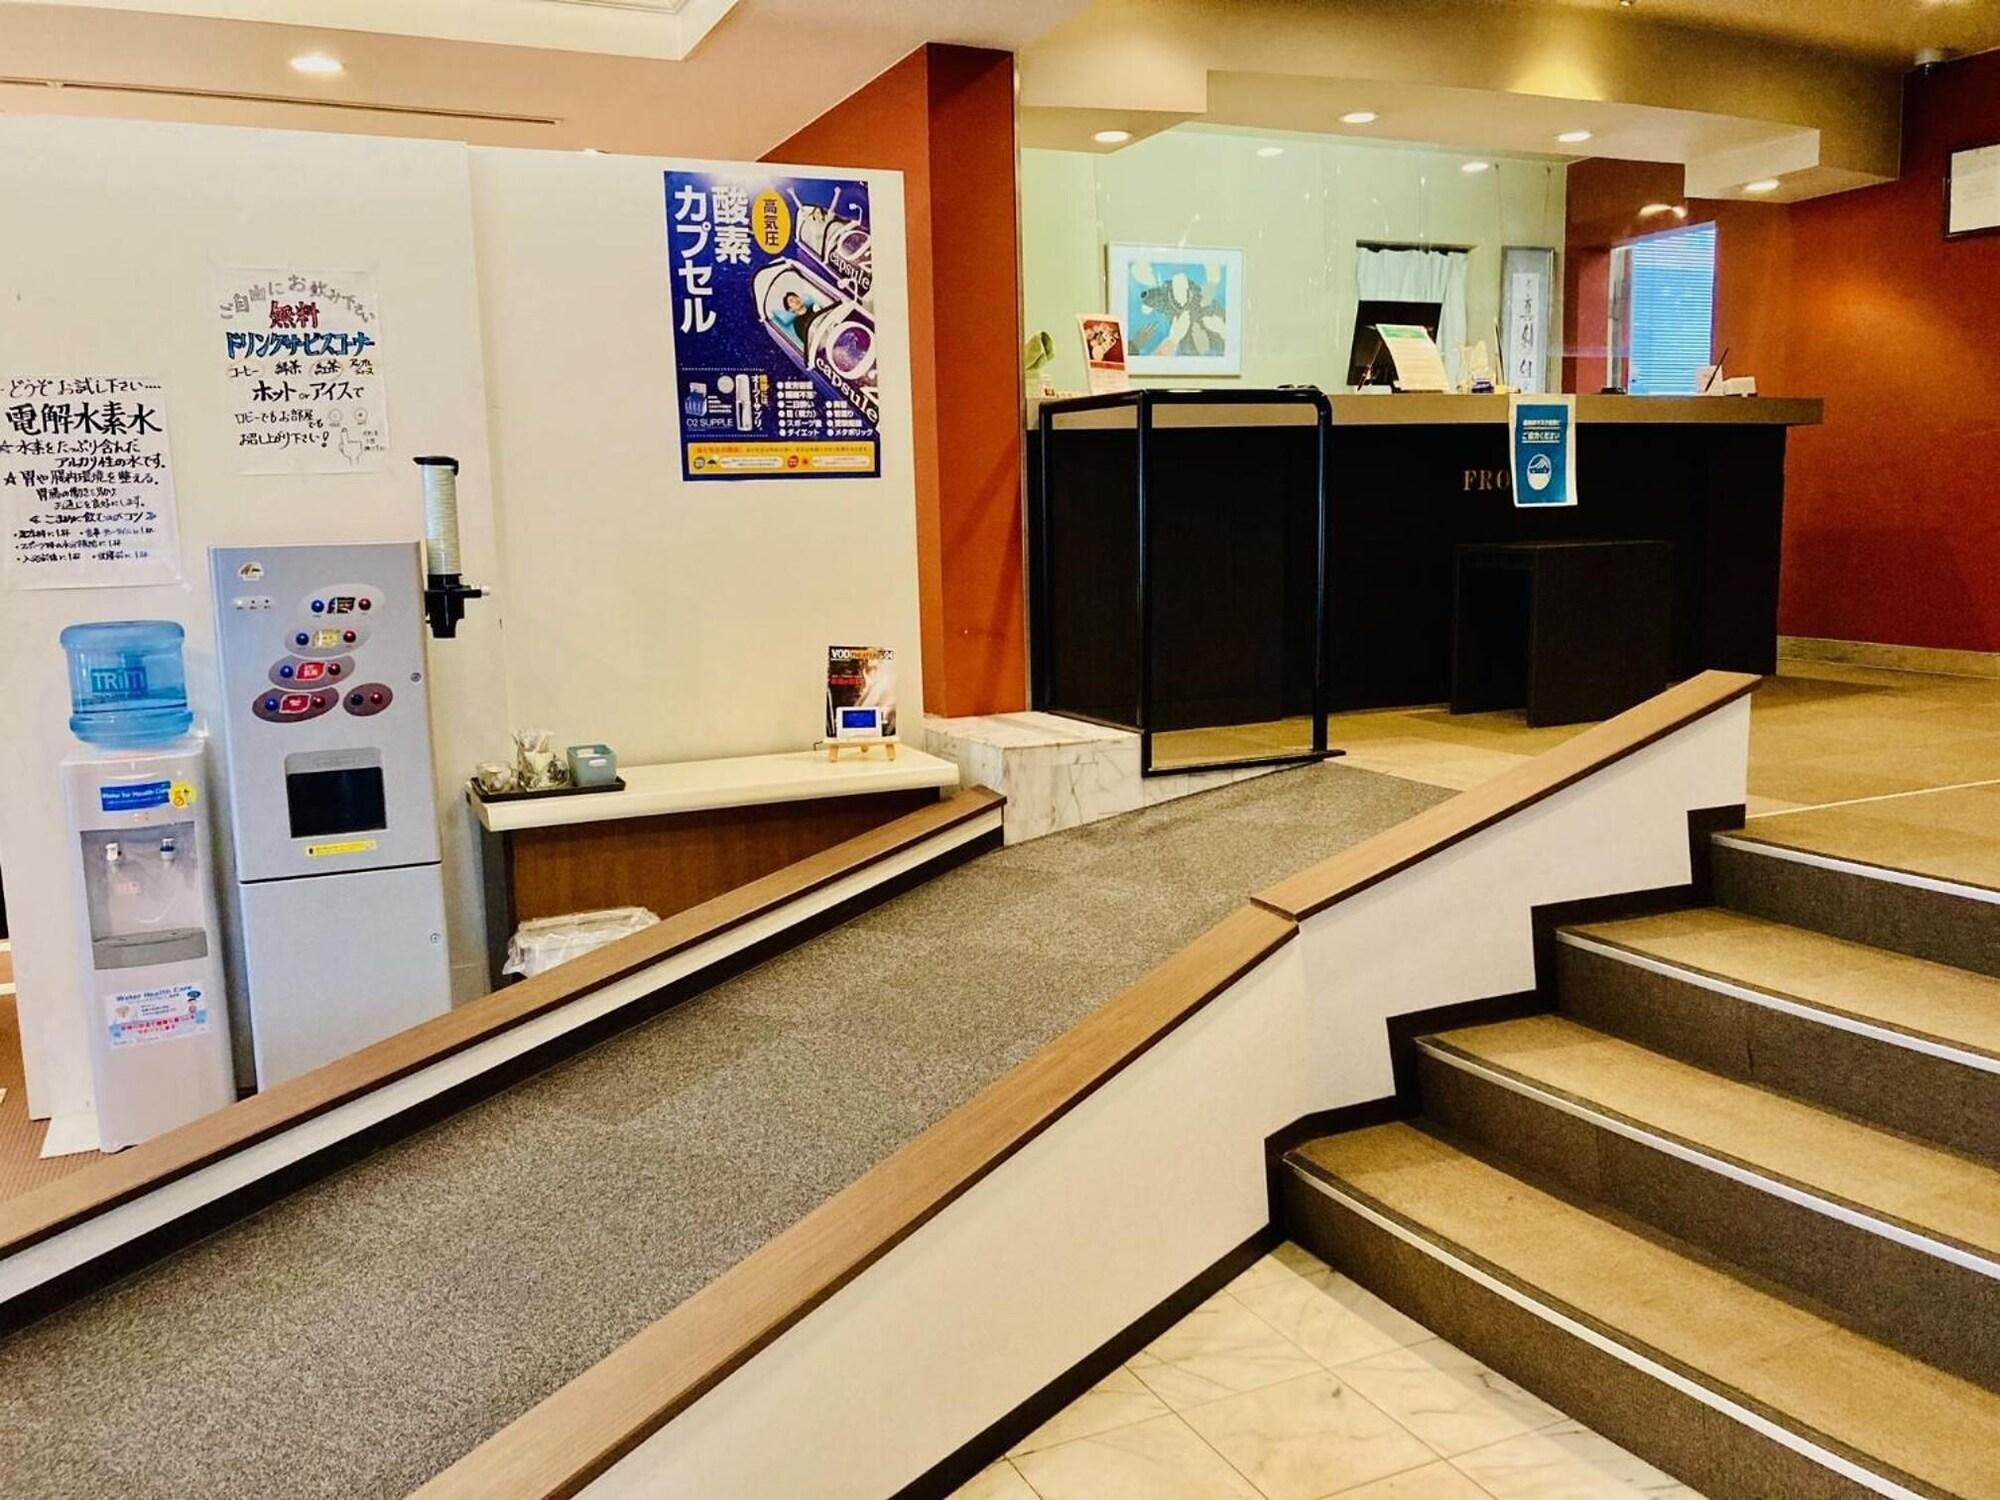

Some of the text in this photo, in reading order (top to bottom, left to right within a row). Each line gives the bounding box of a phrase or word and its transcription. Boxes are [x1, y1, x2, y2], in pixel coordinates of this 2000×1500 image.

[712, 185, 751, 264] 酸素
[763, 198, 780, 247] 高気圧
[674, 185, 717, 334] カプセル
[828, 252, 870, 291] capsule
[269, 300, 320, 328] 無料
[230, 365, 259, 377] コーヒー
[252, 380, 297, 401] ホット
[309, 381, 364, 401] アイスで
[815, 358, 878, 423] capsule
[5, 401, 163, 436] 電解水素水
[787, 428, 820, 437] ダイエット
[834, 428, 874, 437] メタボリック
[1463, 469, 1511, 491] FRO
